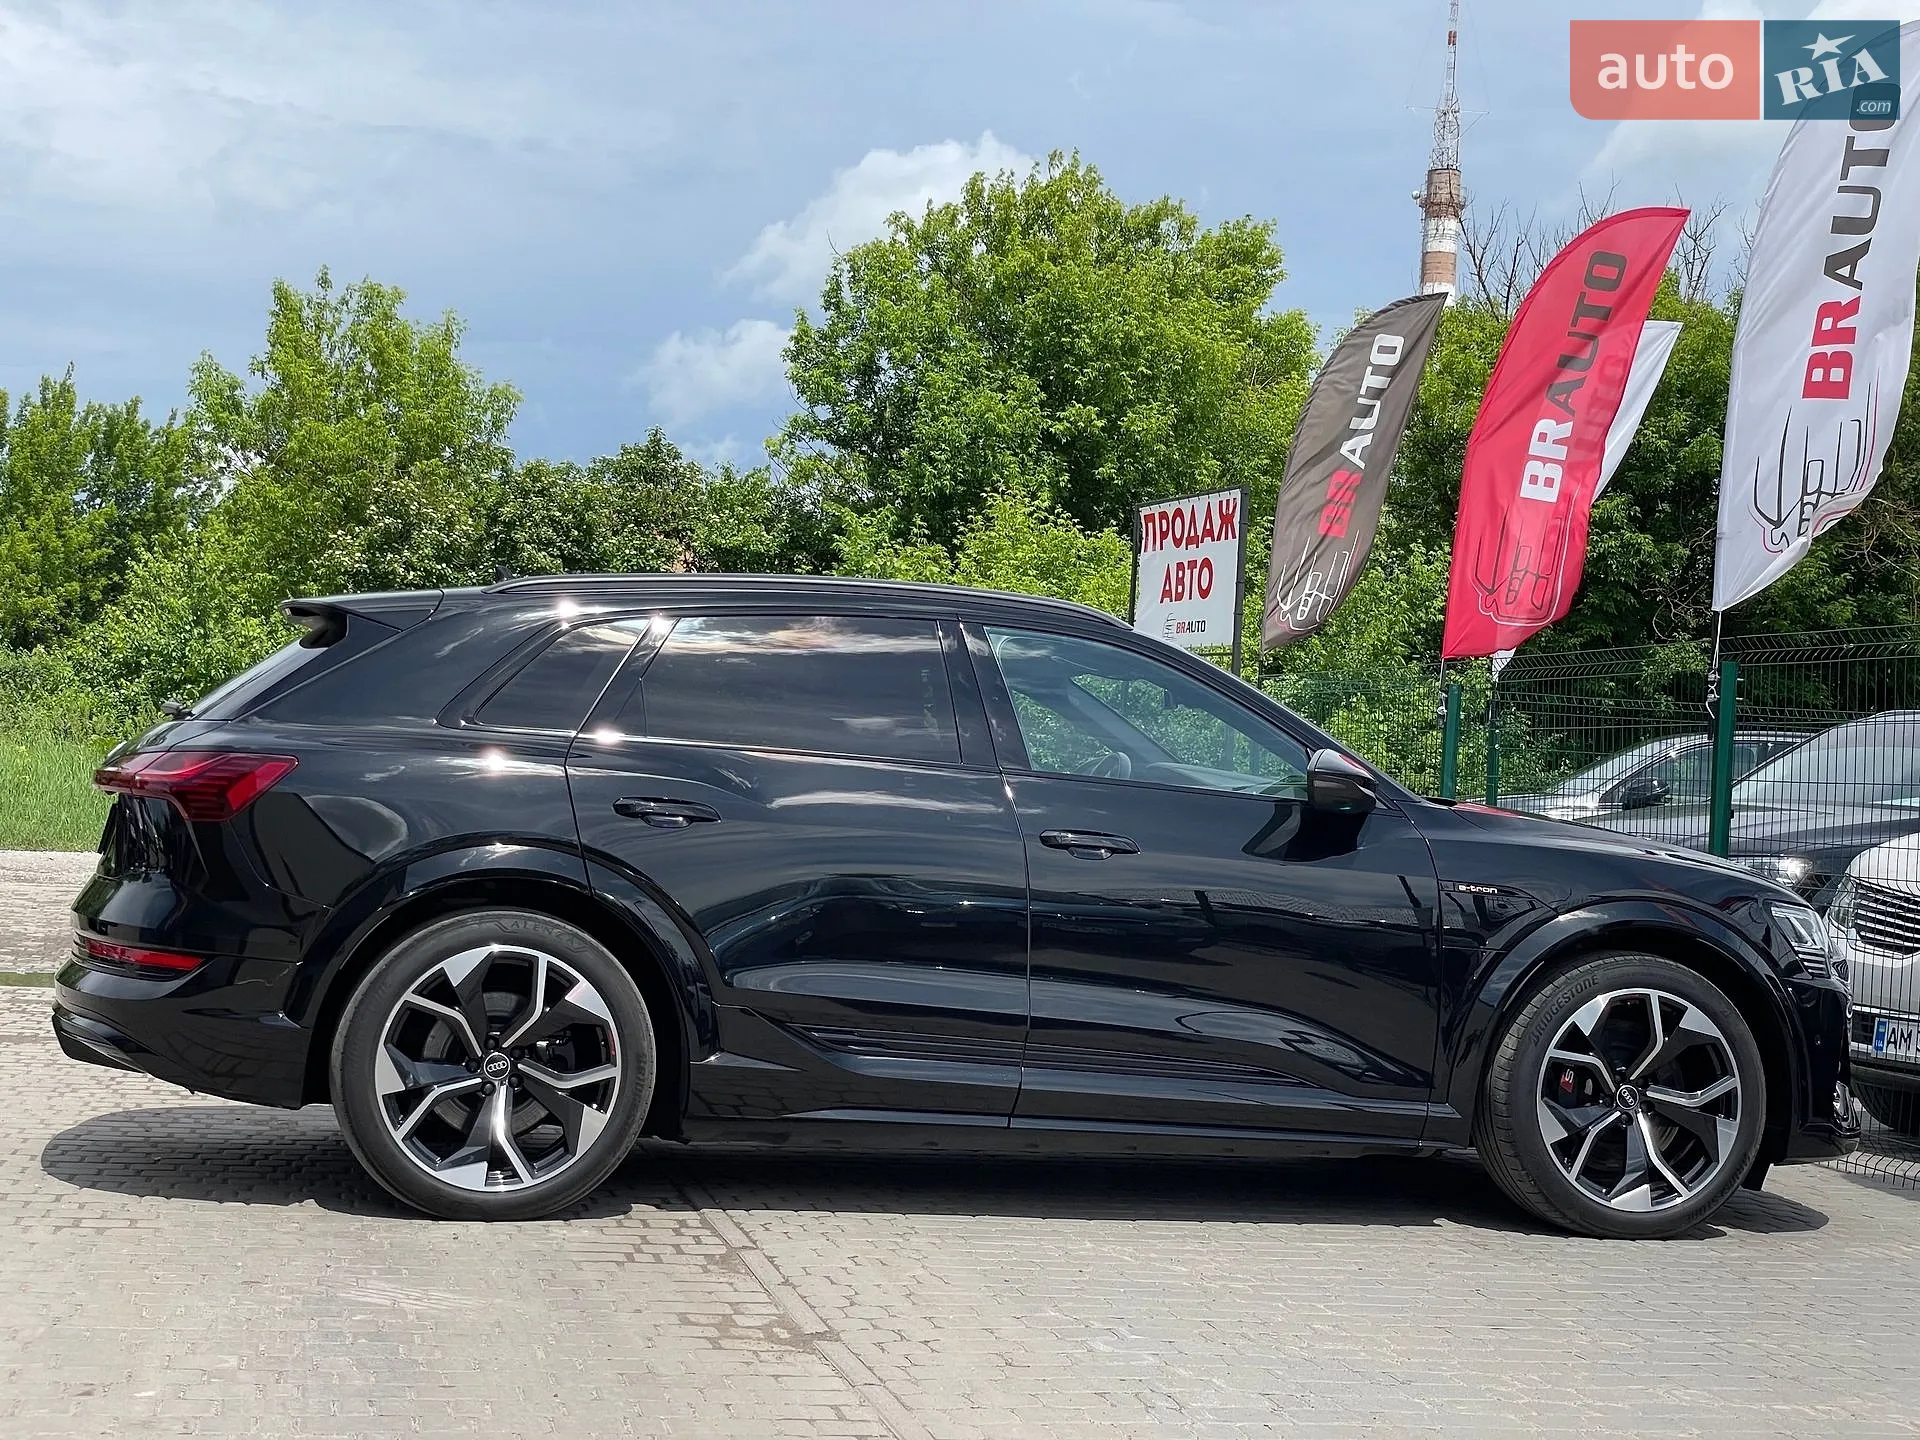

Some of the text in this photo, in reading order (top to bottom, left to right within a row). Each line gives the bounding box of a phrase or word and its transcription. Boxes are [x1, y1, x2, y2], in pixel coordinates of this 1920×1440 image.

[1802, 82, 1902, 400] BRAUTO
[1519, 249, 1629, 504] BRAUTO
[1317, 333, 1405, 539] BRAUTO
[1143, 497, 1237, 553] ПРОДАЖ
[1159, 556, 1214, 604] АВТО
[1175, 619, 1206, 634] BRAUTO
[1458, 884, 1498, 894] e-tron
